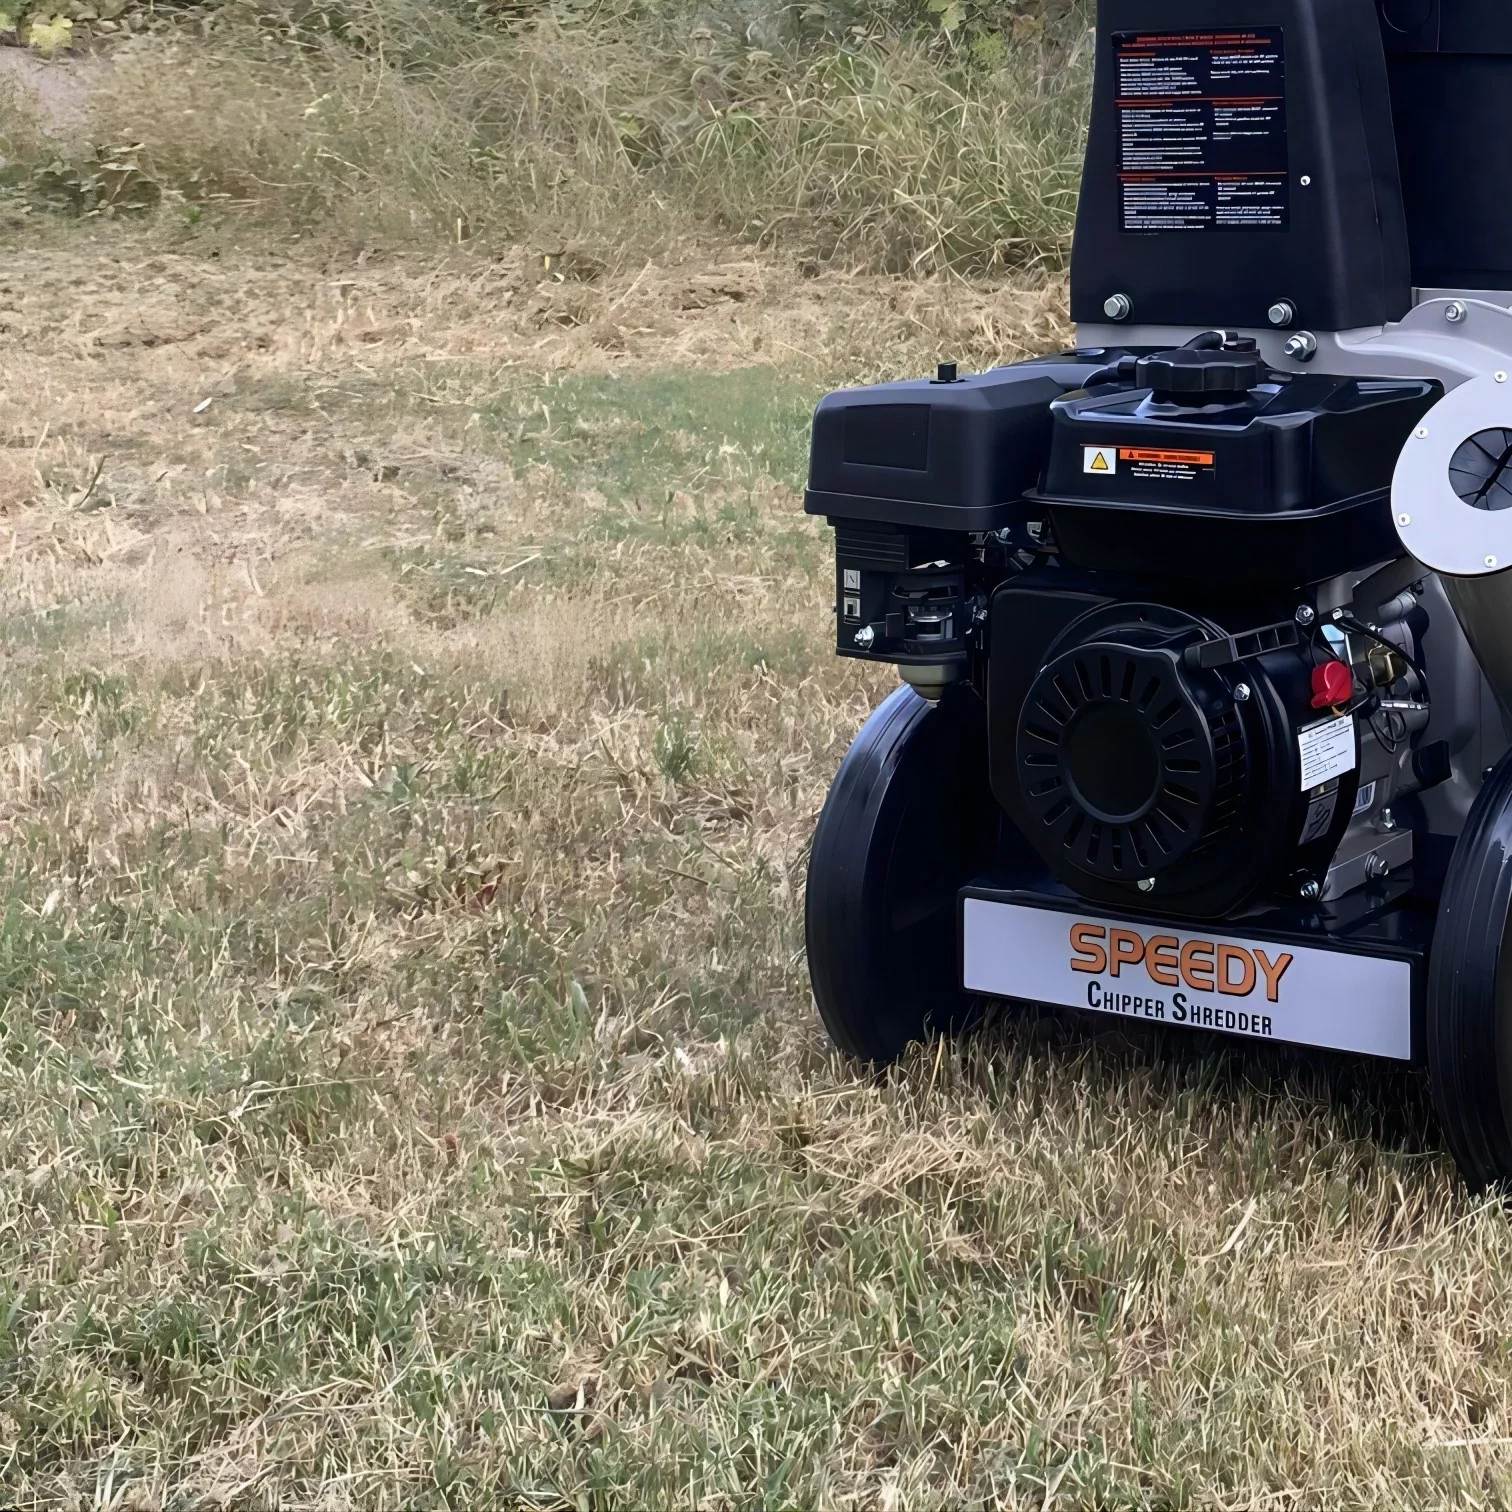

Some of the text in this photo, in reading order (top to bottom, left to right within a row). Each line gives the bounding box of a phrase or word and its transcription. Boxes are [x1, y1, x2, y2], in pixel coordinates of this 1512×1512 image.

[1069, 922, 1294, 1003] SPEEDY
[1087, 980, 1272, 1035] CHIPPER SHREDDER
